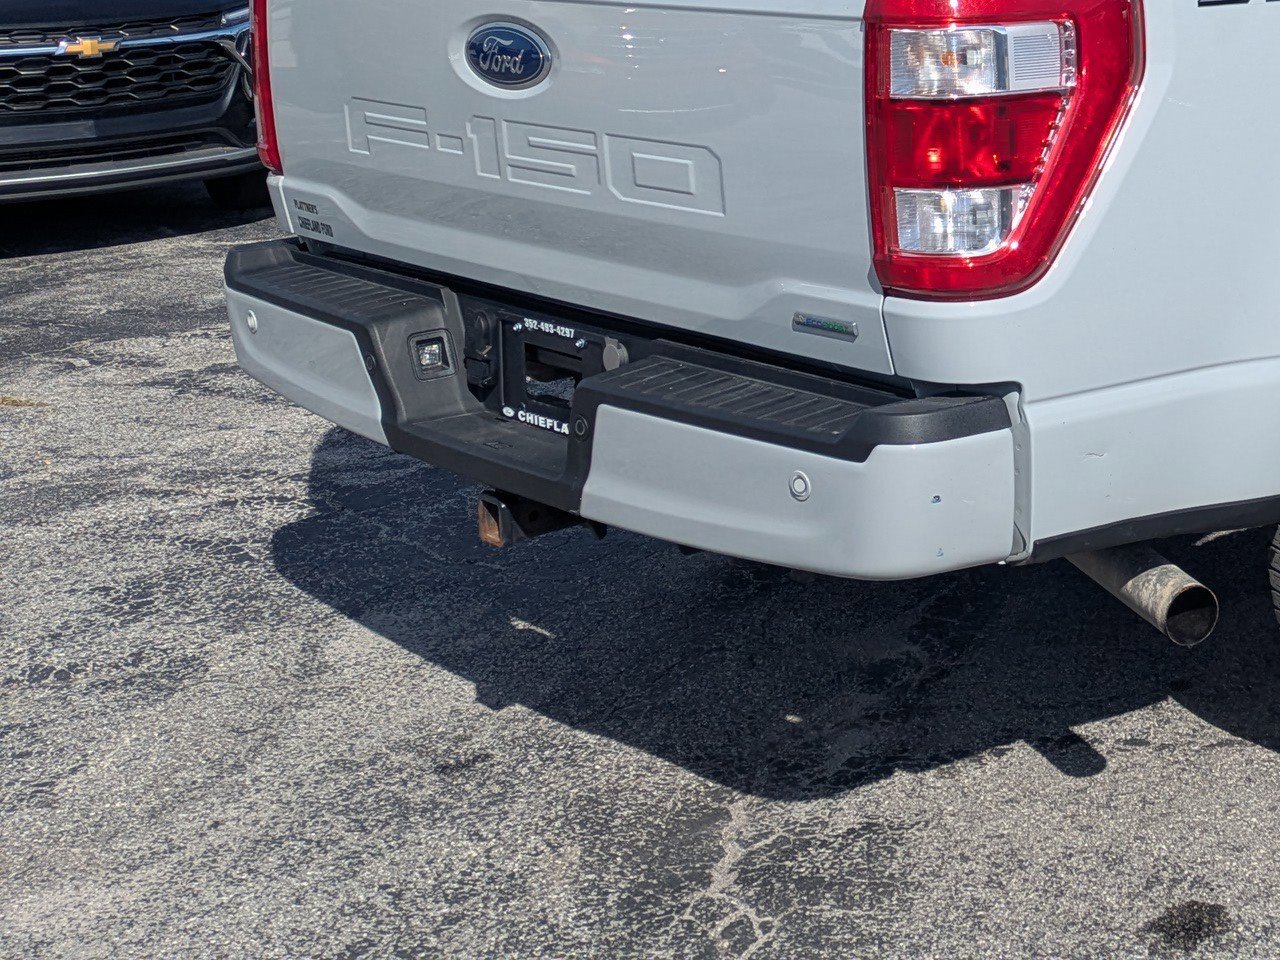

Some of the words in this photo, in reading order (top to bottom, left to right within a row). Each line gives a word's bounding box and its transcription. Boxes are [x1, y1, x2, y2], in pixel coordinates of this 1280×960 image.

[480, 35, 525, 75] Ford
[343, 96, 727, 218] F-150
[524, 317, 575, 339] 352-493-4297
